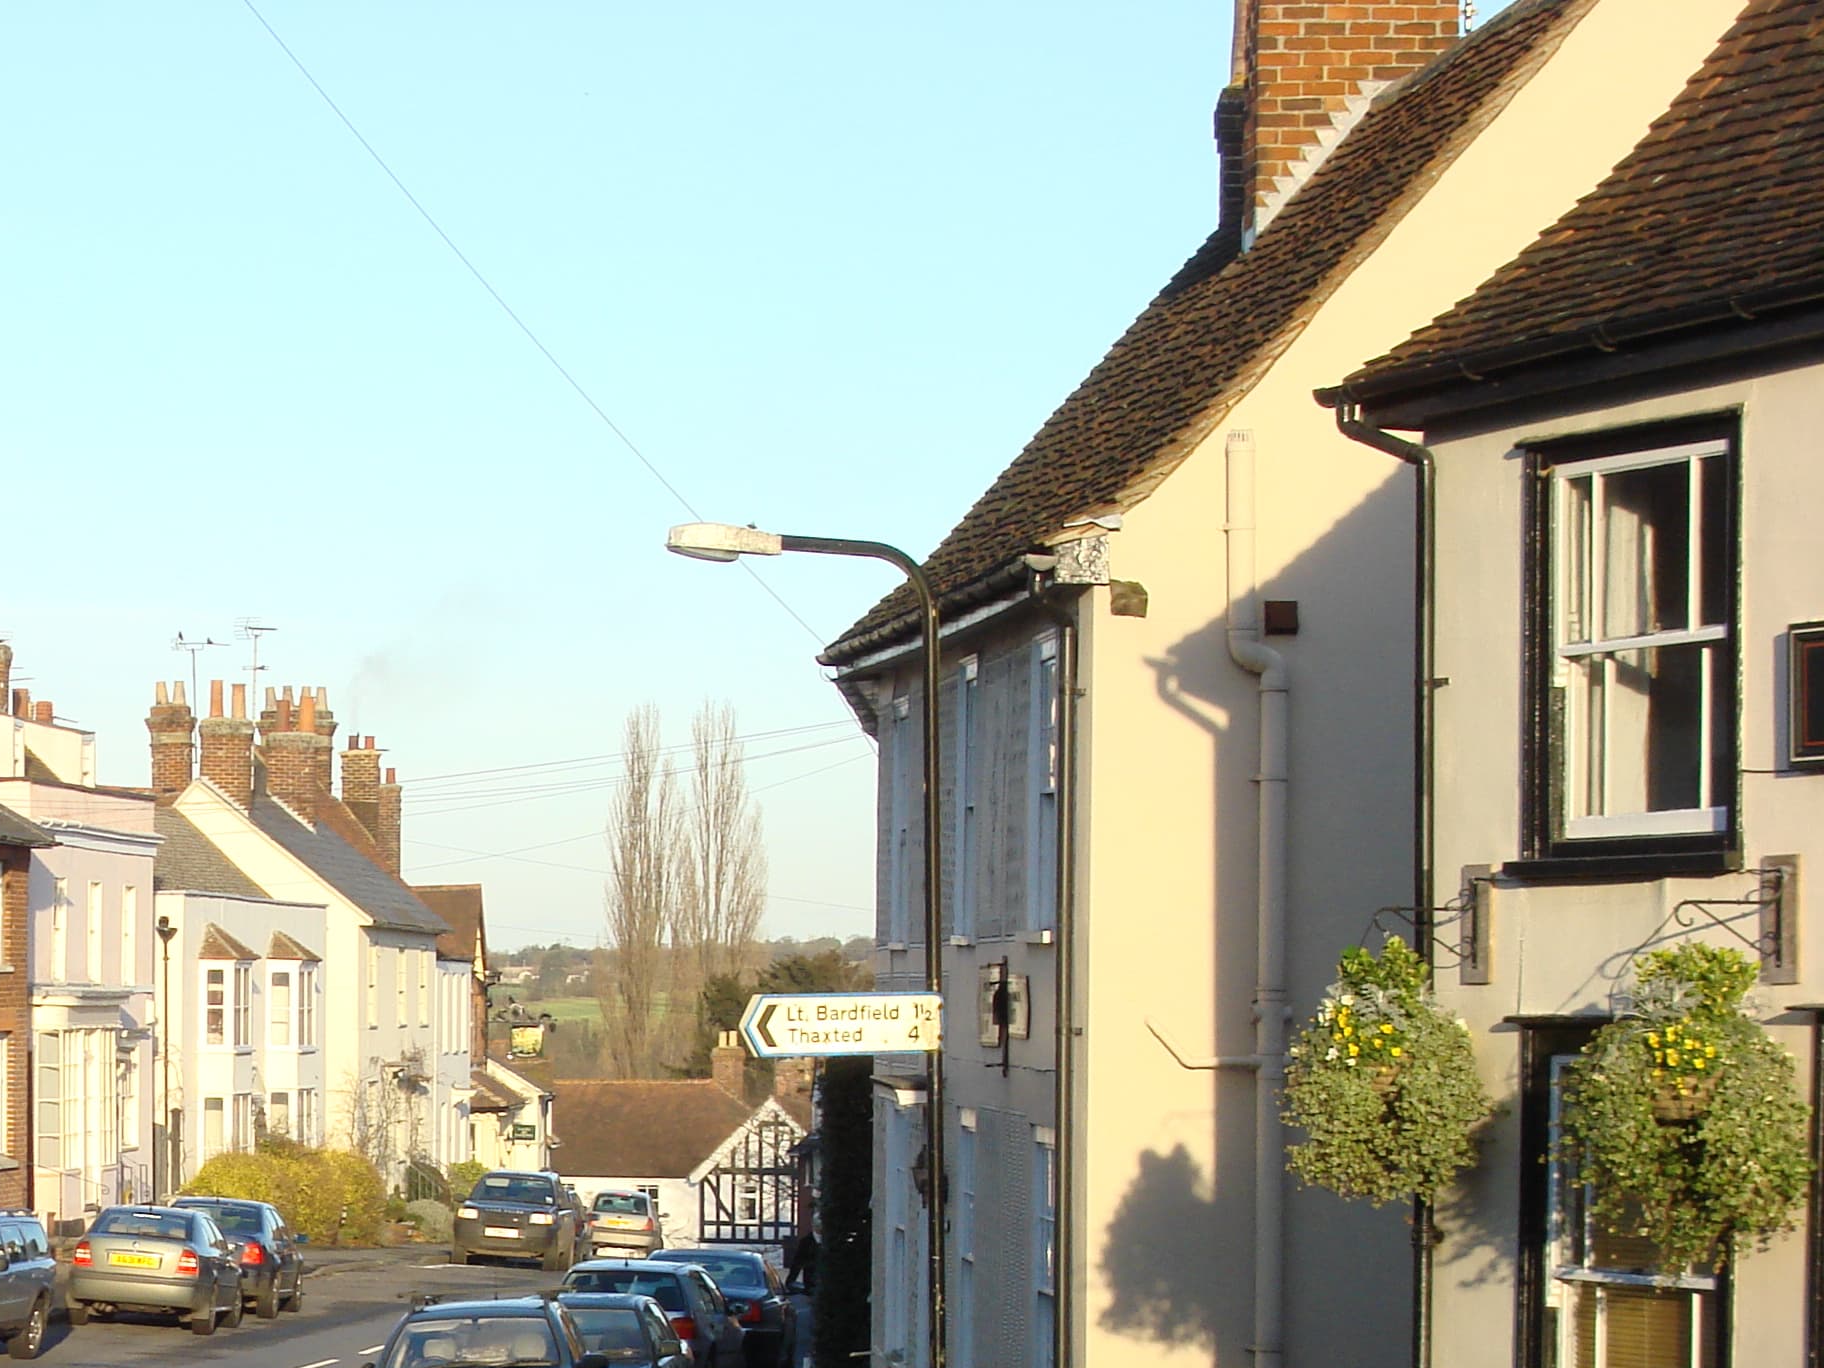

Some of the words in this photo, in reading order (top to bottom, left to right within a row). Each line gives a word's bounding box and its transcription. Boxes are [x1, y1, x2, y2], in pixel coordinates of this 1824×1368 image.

[787, 1006, 809, 1022] Lt.
[816, 1002, 900, 1021] Bardfield
[787, 1027, 863, 1044] Thaxted
[908, 1025, 920, 1043] 4
